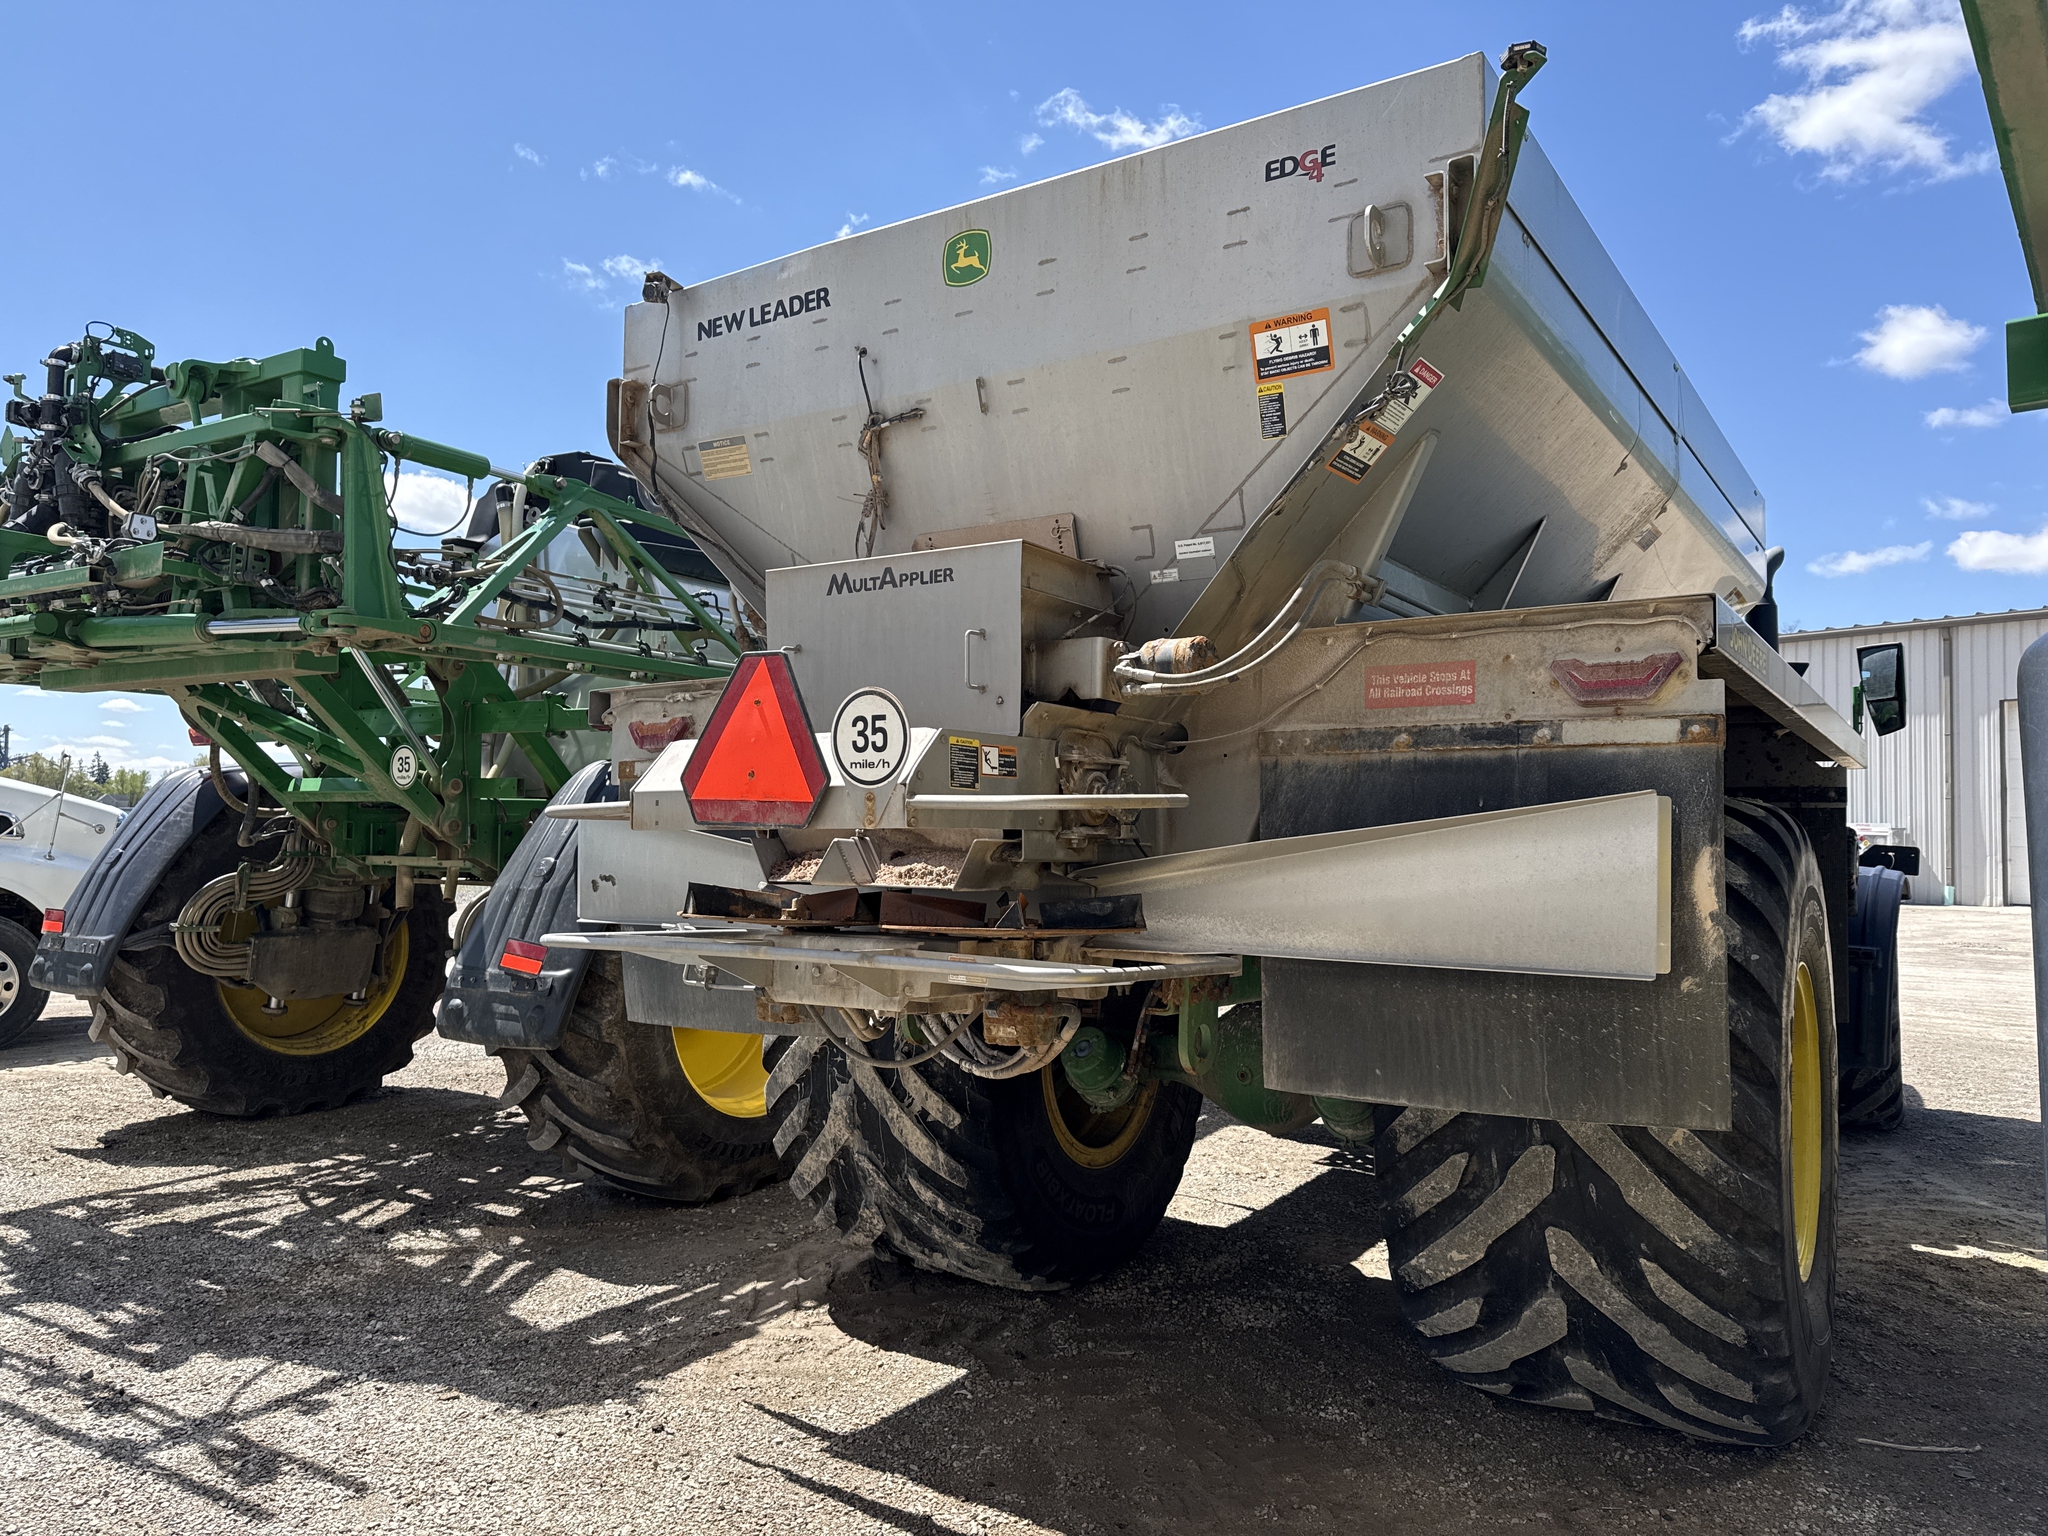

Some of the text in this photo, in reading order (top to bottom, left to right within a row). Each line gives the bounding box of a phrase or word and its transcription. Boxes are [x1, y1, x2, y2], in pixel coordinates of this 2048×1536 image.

[1265, 144, 1336, 182] EDGE
[698, 287, 831, 341] NEW LEADER
[1273, 312, 1313, 327] WARNING
[1419, 367, 1438, 384] DANGER
[1263, 384, 1283, 392] CAUTION
[1371, 427, 1389, 441] WARNING
[712, 440, 731, 448] NOTICE
[1371, 669, 1471, 686] This Vehicle Stops At
[1368, 683, 1473, 699] All Railroad Crossings
[851, 714, 888, 754] 35
[397, 756, 411, 773] 35
[850, 759, 890, 769] mile/h
